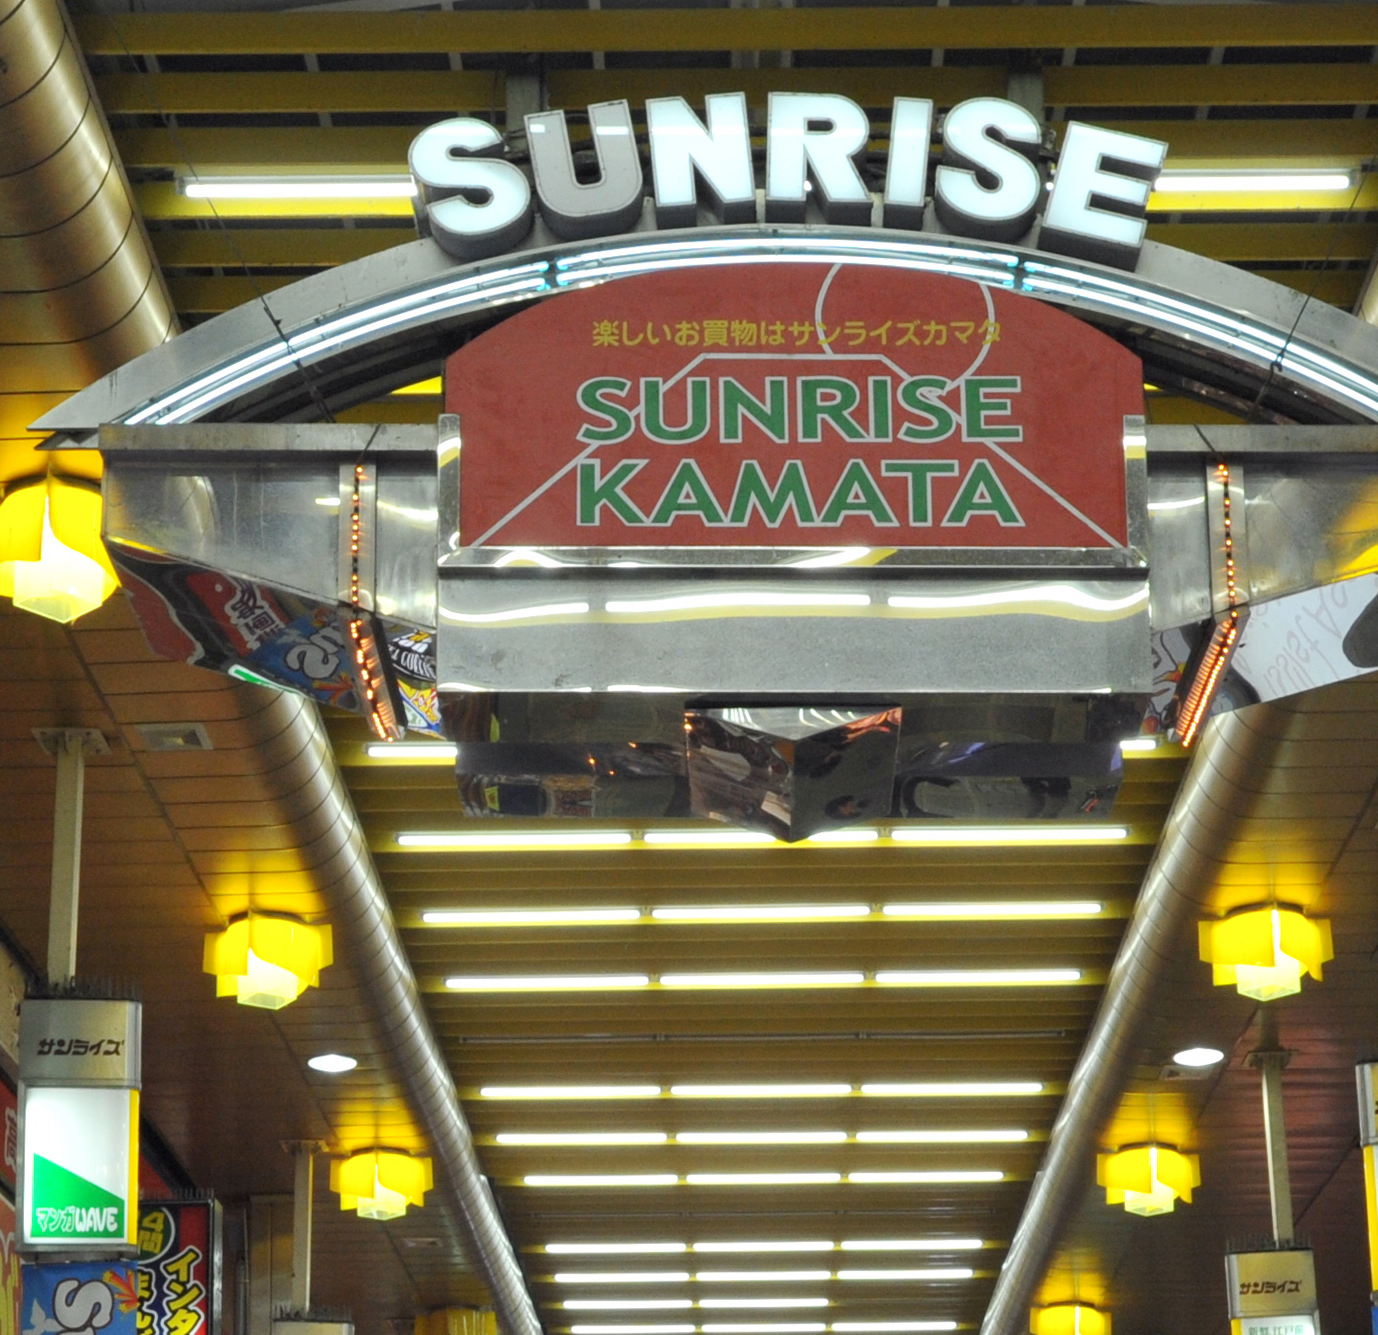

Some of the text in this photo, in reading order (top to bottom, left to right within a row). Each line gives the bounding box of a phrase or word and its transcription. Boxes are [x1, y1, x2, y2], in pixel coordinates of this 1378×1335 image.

[406, 91, 1169, 252] SUNRISE
[591, 318, 1001, 348] 楽しいお買物はサンライズカマタ
[576, 375, 1023, 443] SUNRISE
[576, 459, 1026, 528] KAMATA
[37, 1038, 125, 1056] サンライズ
[1239, 1279, 1303, 1295] サンライズ
